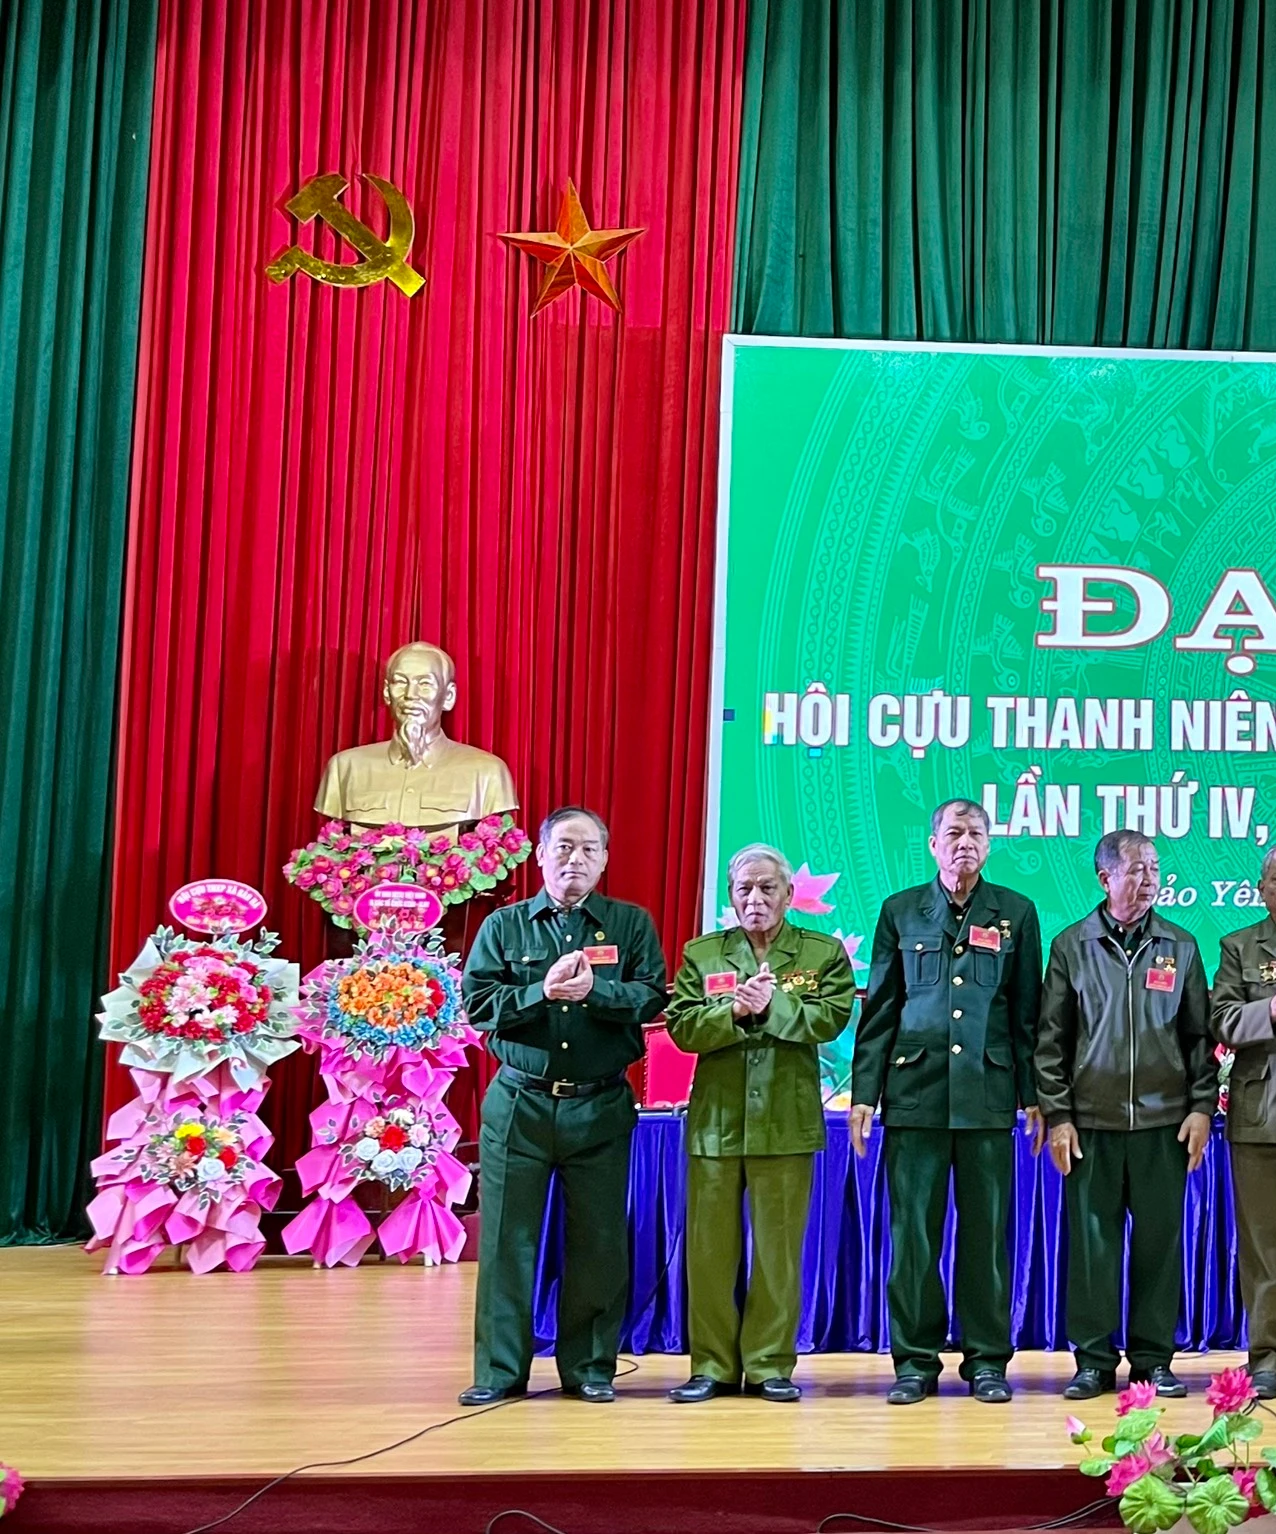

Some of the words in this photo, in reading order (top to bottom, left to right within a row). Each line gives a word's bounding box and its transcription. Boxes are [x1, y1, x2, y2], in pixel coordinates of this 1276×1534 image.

[763, 681, 849, 759] HỘI
[867, 689, 970, 759] CỰU
[986, 696, 1153, 750] THANH
[982, 765, 1080, 836] LẦN
[1096, 771, 1199, 838] THỨ
[1209, 786, 1268, 847] IV,
[1152, 873, 1197, 907] ảo
